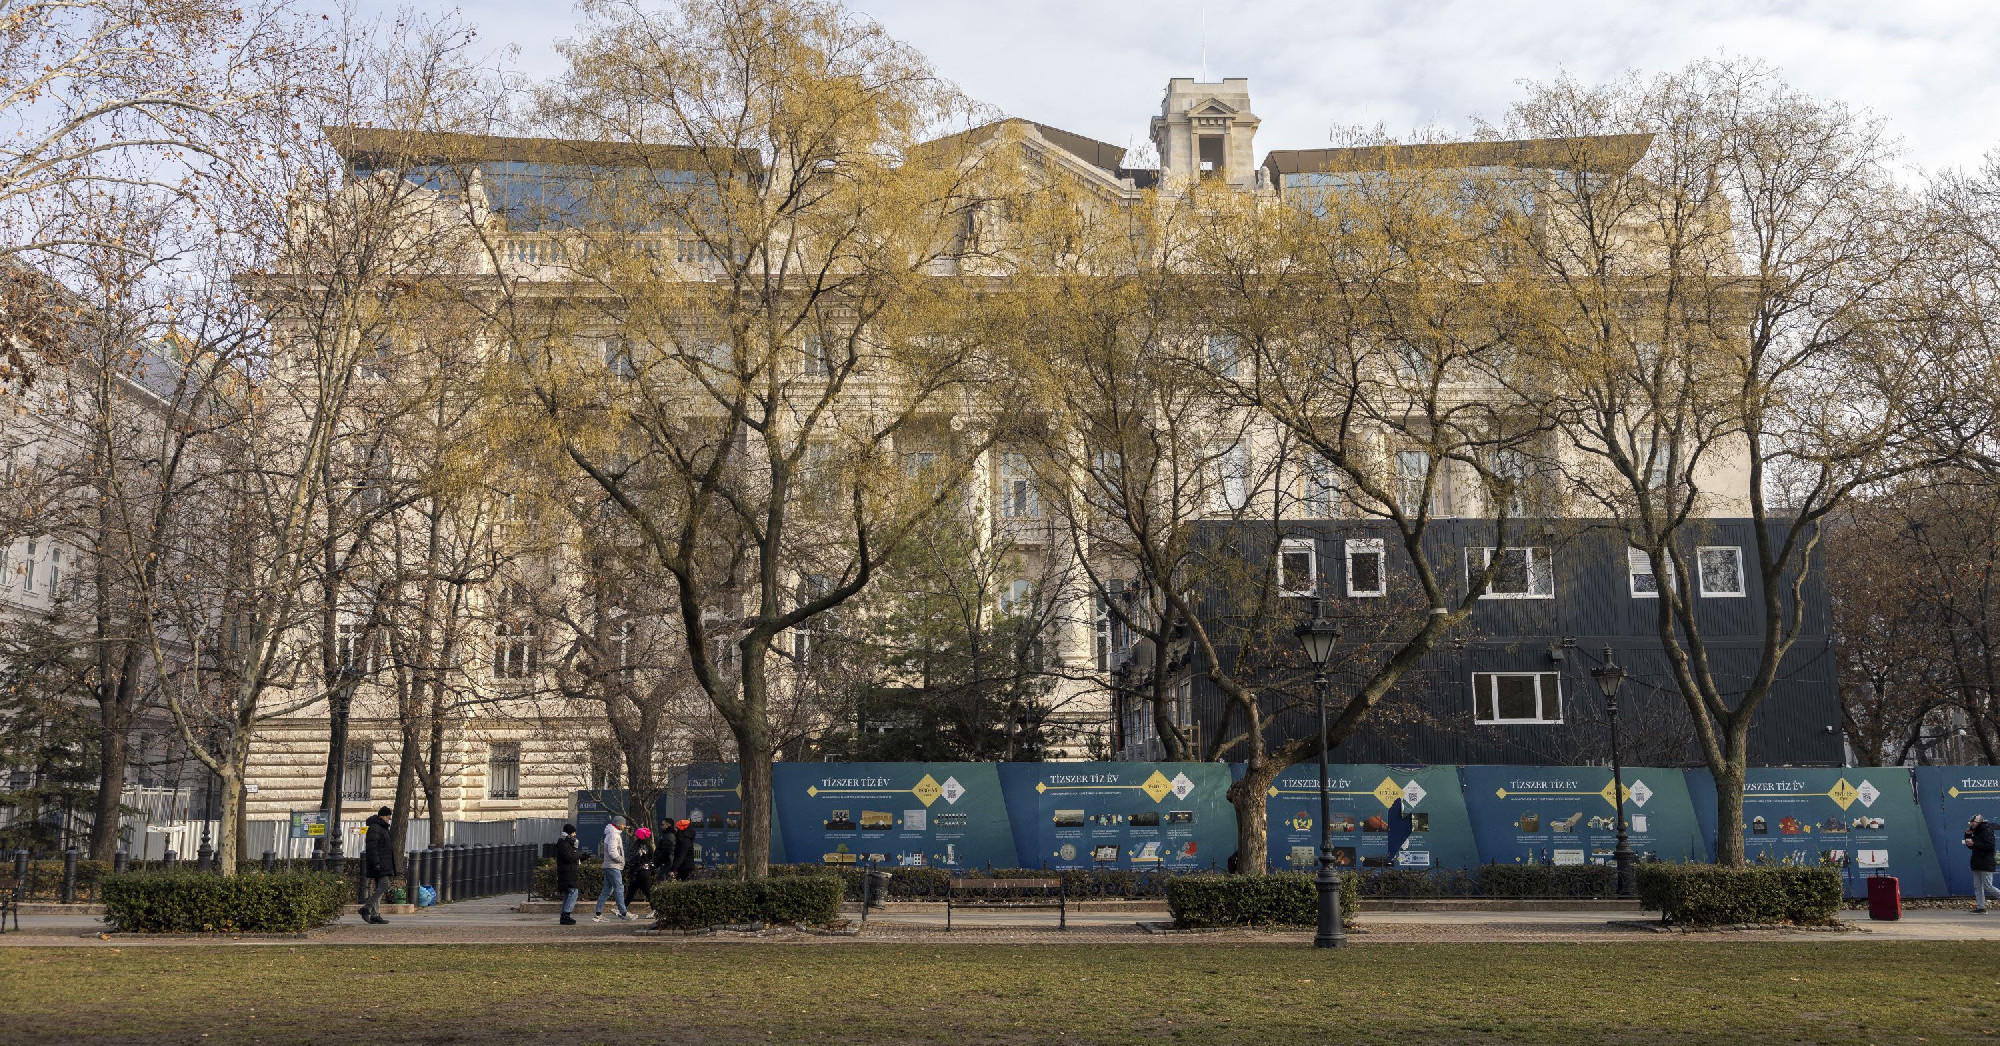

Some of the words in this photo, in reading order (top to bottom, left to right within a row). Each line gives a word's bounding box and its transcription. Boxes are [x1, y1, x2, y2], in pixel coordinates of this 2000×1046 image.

[821, 777, 859, 787] TÍZSZER
[861, 777, 876, 787] TÍZ
[877, 777, 890, 787] ÉV
[1050, 774, 1088, 784] TÍZSZER
[1090, 774, 1105, 784] TÍZ
[1107, 773, 1119, 783] ÉV
[1339, 778, 1351, 788] ÉV
[1961, 777, 1999, 788] TÍZSZER
[1510, 779, 1547, 789] TÍZSZER
[1550, 779, 1564, 789] TÍZ
[1776, 780, 1791, 790] TÍZ
[1793, 780, 1805, 790] ÉV
